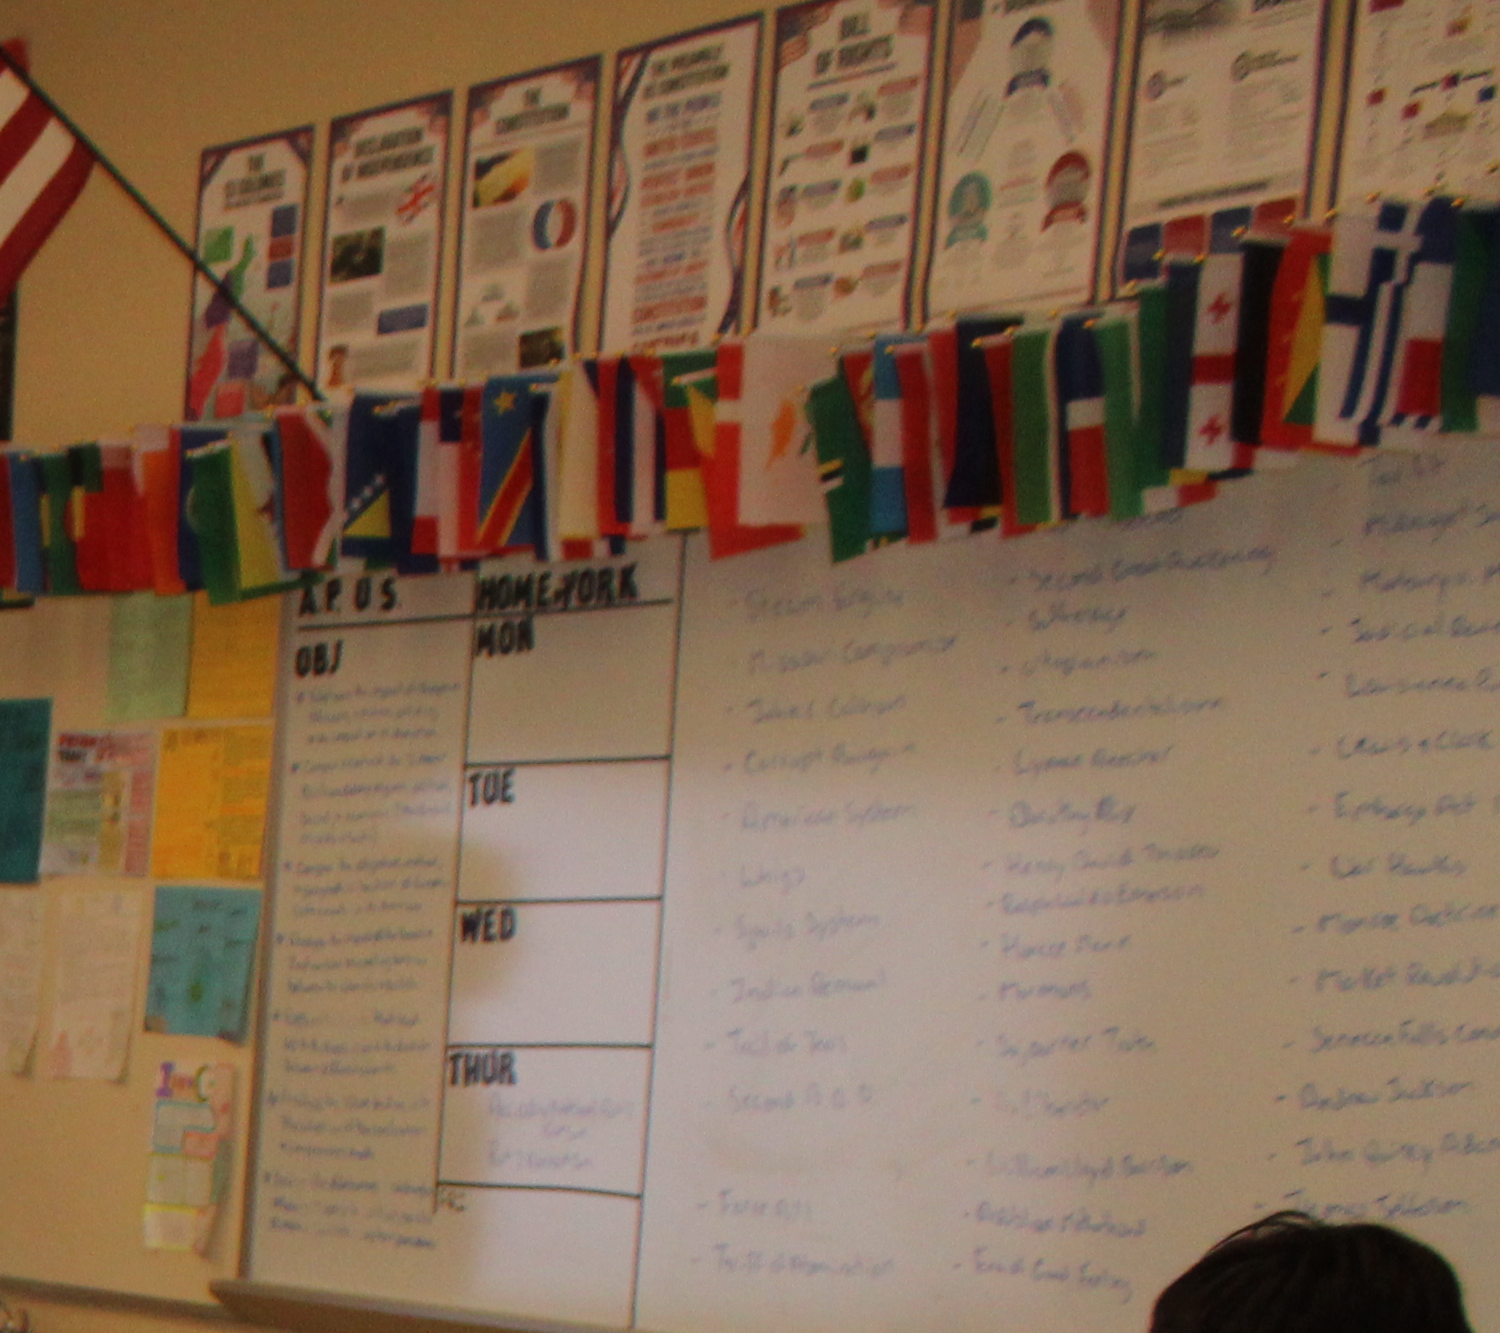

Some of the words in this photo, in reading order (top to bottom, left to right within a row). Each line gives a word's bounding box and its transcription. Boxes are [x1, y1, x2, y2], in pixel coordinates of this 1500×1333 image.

[474, 617, 534, 656] MON
[295, 640, 343, 677] OBJ
[469, 770, 515, 805] TUE
[461, 906, 515, 942] WED
[449, 1051, 517, 1087] THUR
